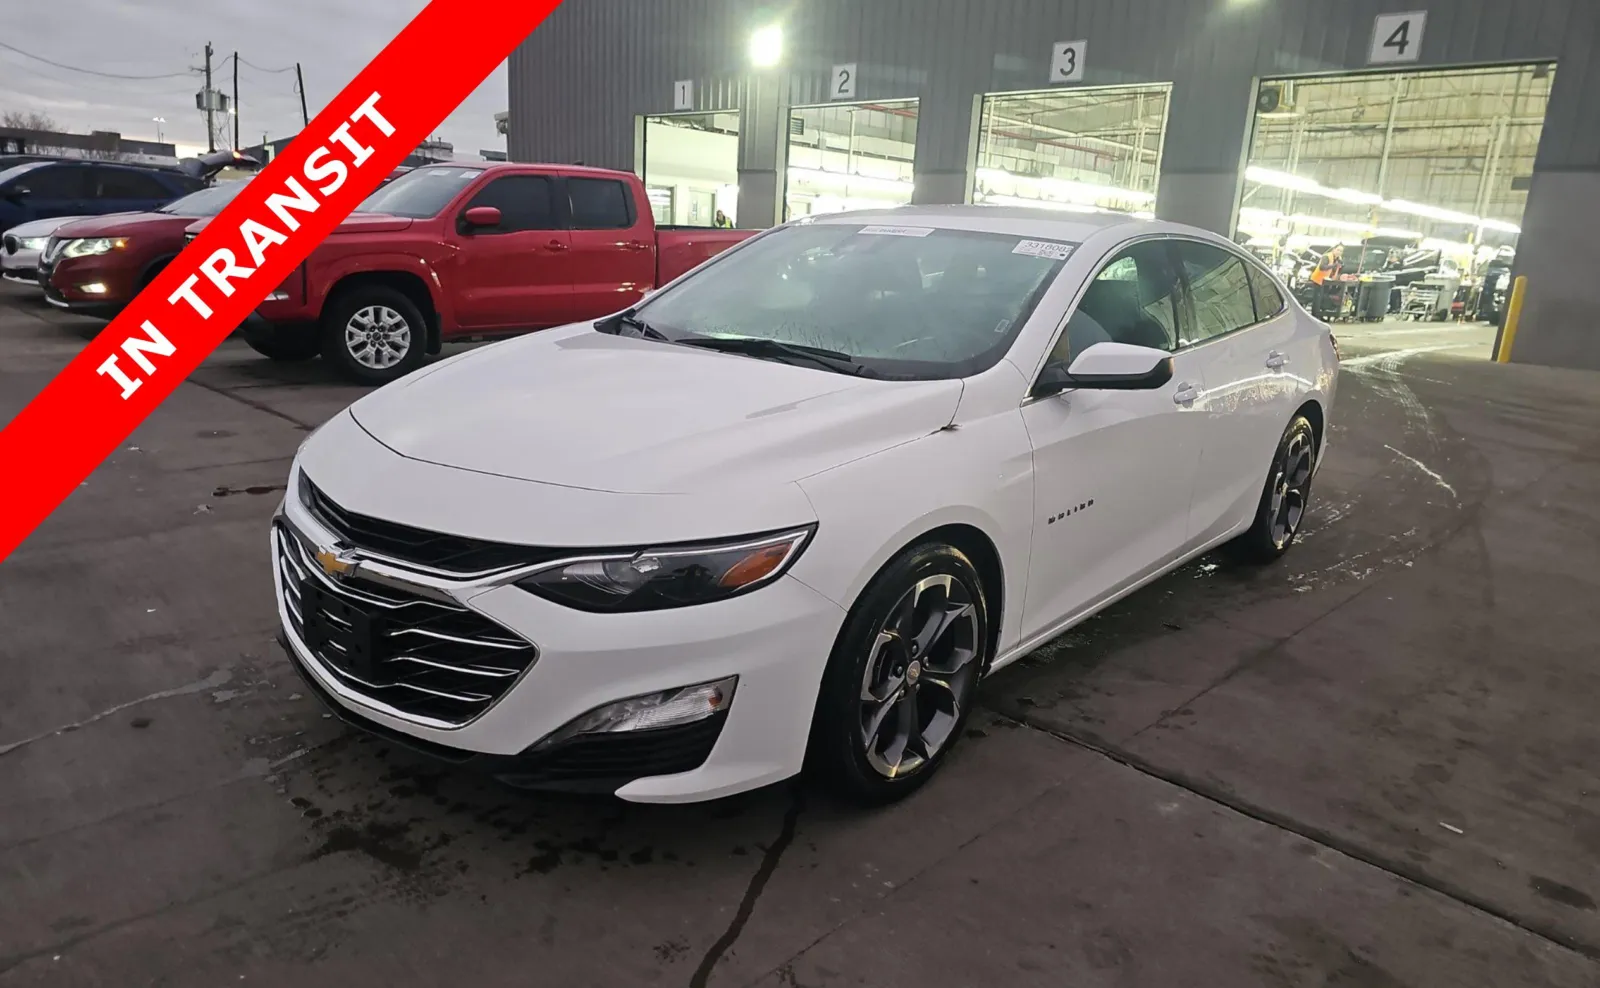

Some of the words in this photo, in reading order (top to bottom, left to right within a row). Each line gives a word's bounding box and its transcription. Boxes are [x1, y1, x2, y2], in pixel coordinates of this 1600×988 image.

[1383, 20, 1410, 55] 4
[1060, 47, 1076, 76] 3
[837, 70, 850, 93] 2
[681, 85, 687, 105] 1
